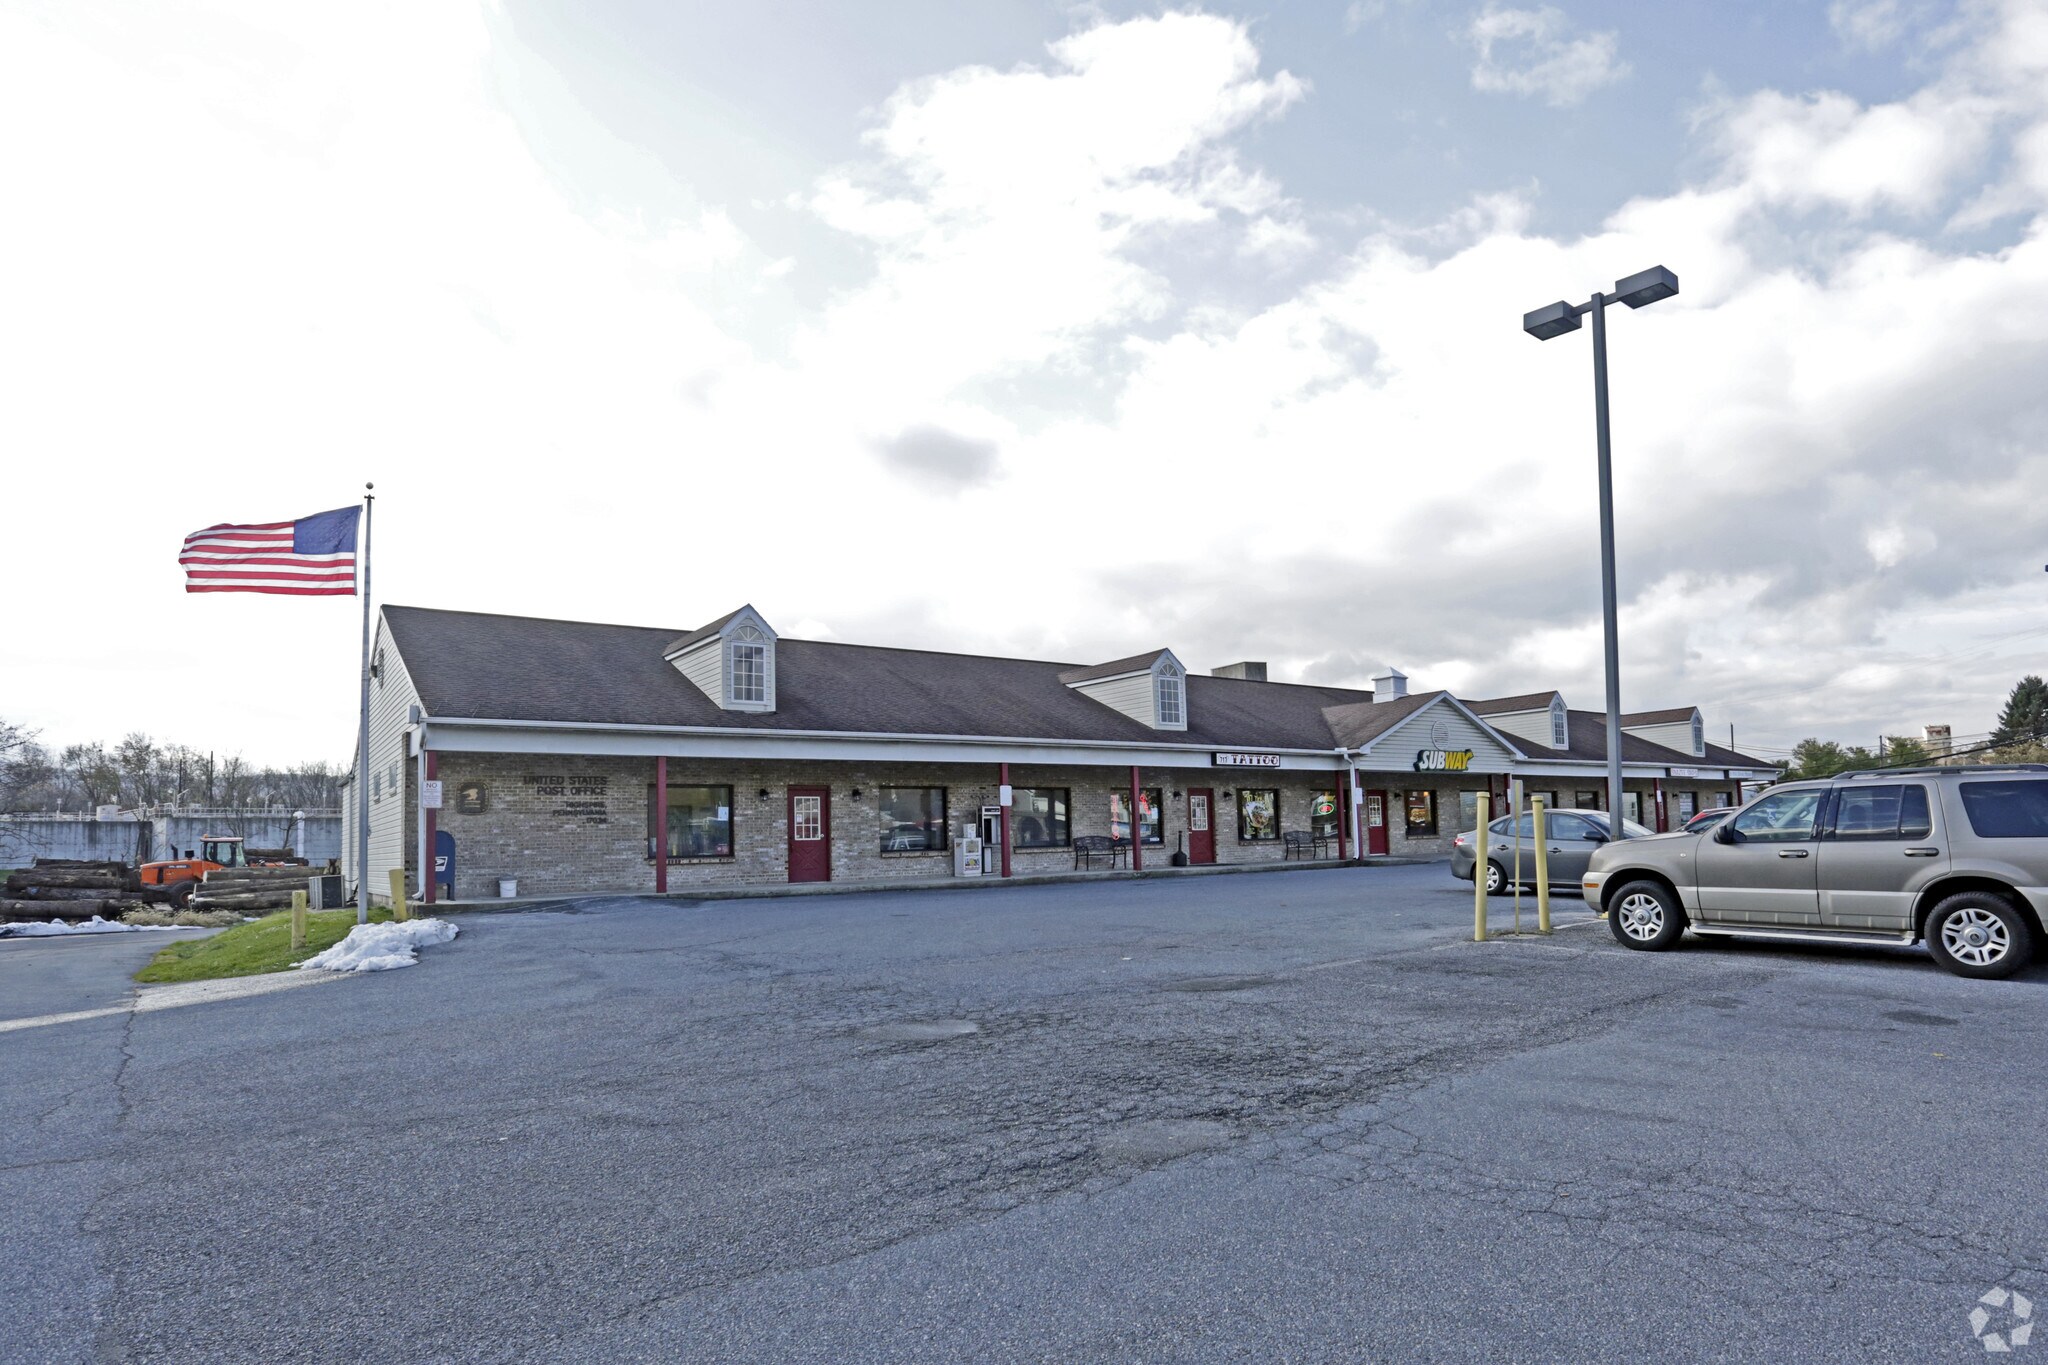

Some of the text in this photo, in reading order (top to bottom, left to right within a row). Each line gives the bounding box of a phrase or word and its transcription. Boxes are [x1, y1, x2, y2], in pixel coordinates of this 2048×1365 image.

[1231, 754, 1279, 765] TATTOO
[1419, 750, 1474, 770] SUBWAY
[523, 776, 607, 785] UNITED STATES
[537, 787, 607, 795] POST OFFICE
